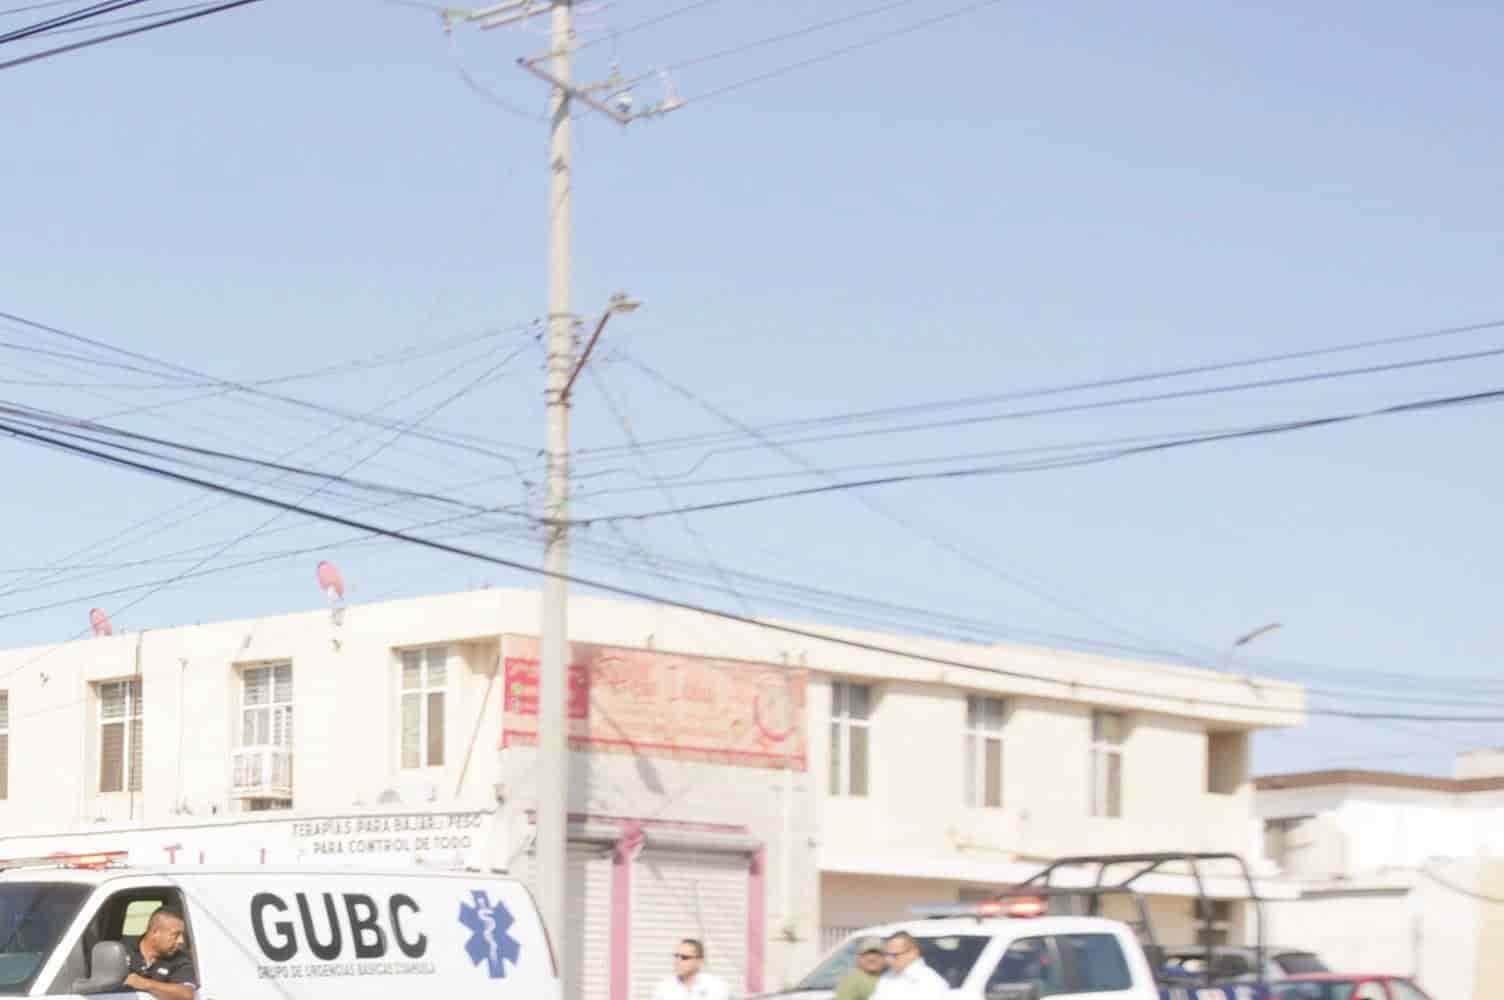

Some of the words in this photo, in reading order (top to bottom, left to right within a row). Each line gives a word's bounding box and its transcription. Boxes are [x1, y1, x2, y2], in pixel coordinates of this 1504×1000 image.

[357, 818, 390, 832] PARA
[312, 841, 344, 854] PARA
[349, 839, 410, 853] CONTROL
[250, 892, 428, 962] GUBC
